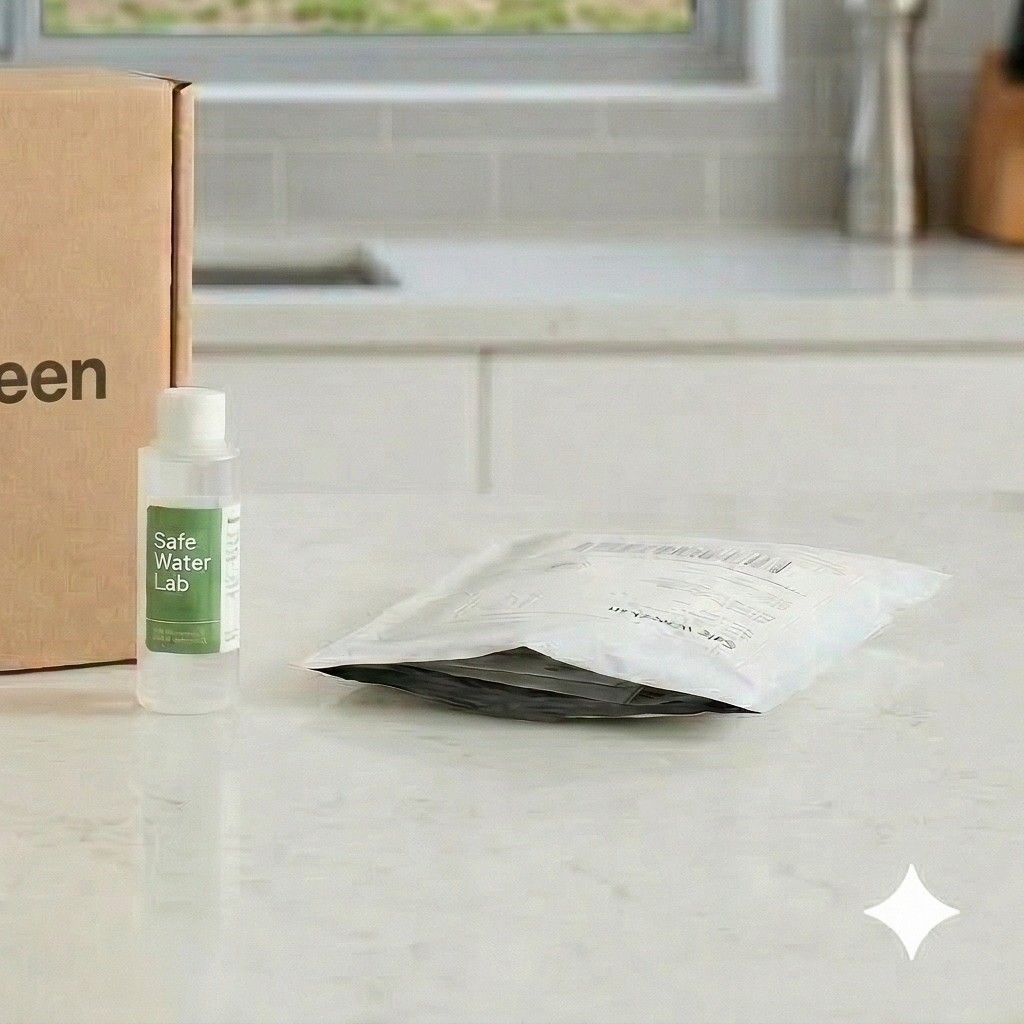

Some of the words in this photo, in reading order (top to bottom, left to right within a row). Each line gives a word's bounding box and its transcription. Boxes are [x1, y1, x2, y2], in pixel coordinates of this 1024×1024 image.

[154, 532, 197, 551] Safe
[154, 552, 212, 572] Water
[154, 573, 190, 592] Lab
